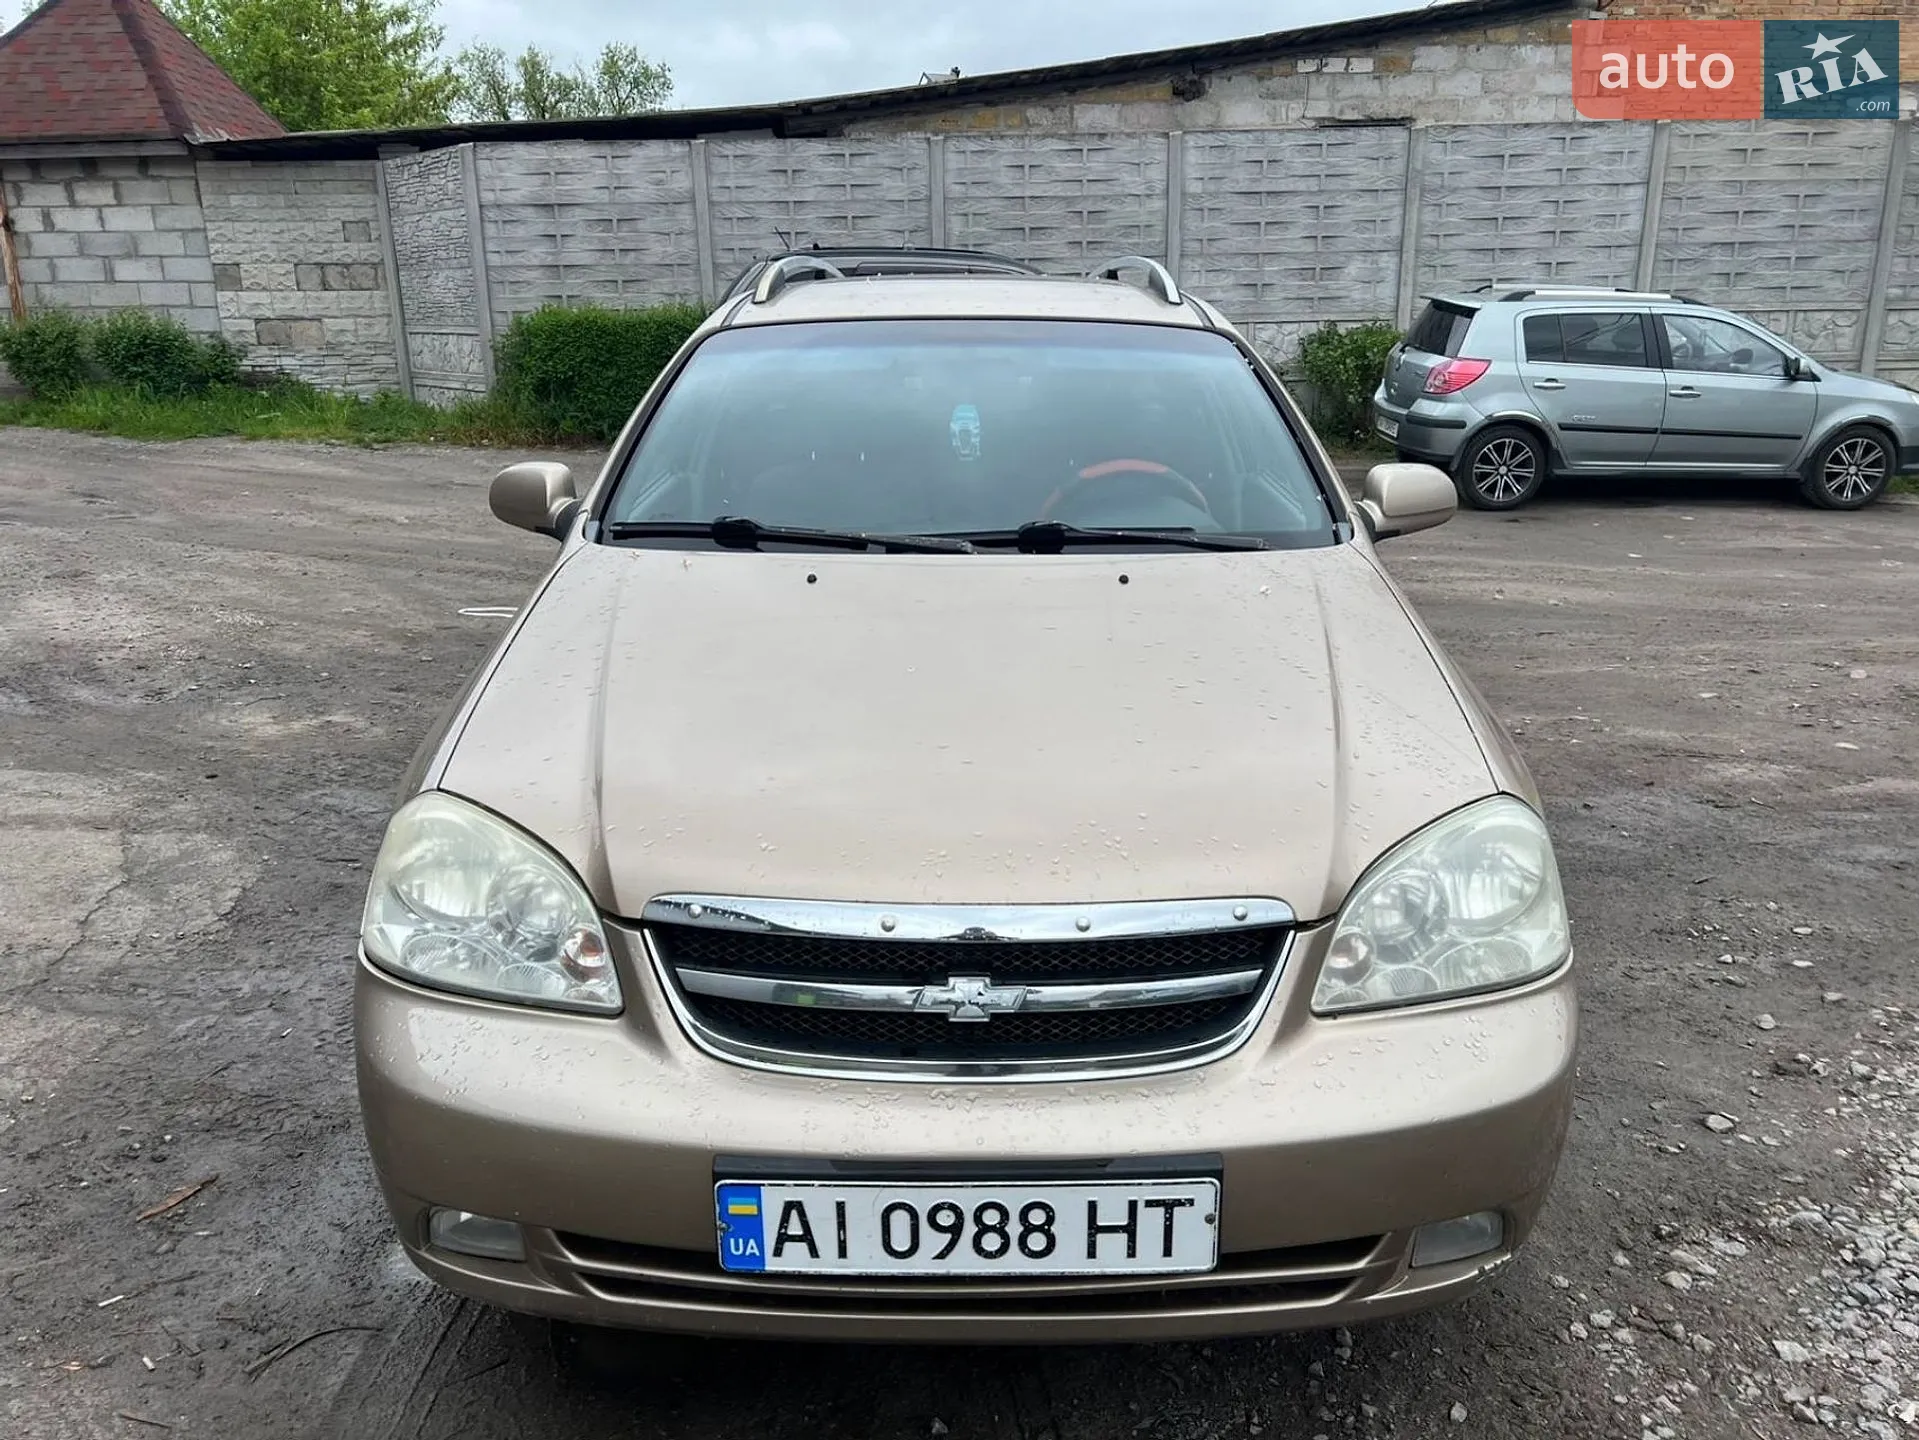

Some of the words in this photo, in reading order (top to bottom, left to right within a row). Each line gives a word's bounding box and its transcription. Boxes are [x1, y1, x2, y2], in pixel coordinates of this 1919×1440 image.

[730, 1238, 760, 1258] UA
[771, 1199, 847, 1260] AI
[880, 1199, 1057, 1261] 0988
[1085, 1197, 1195, 1260] HT
